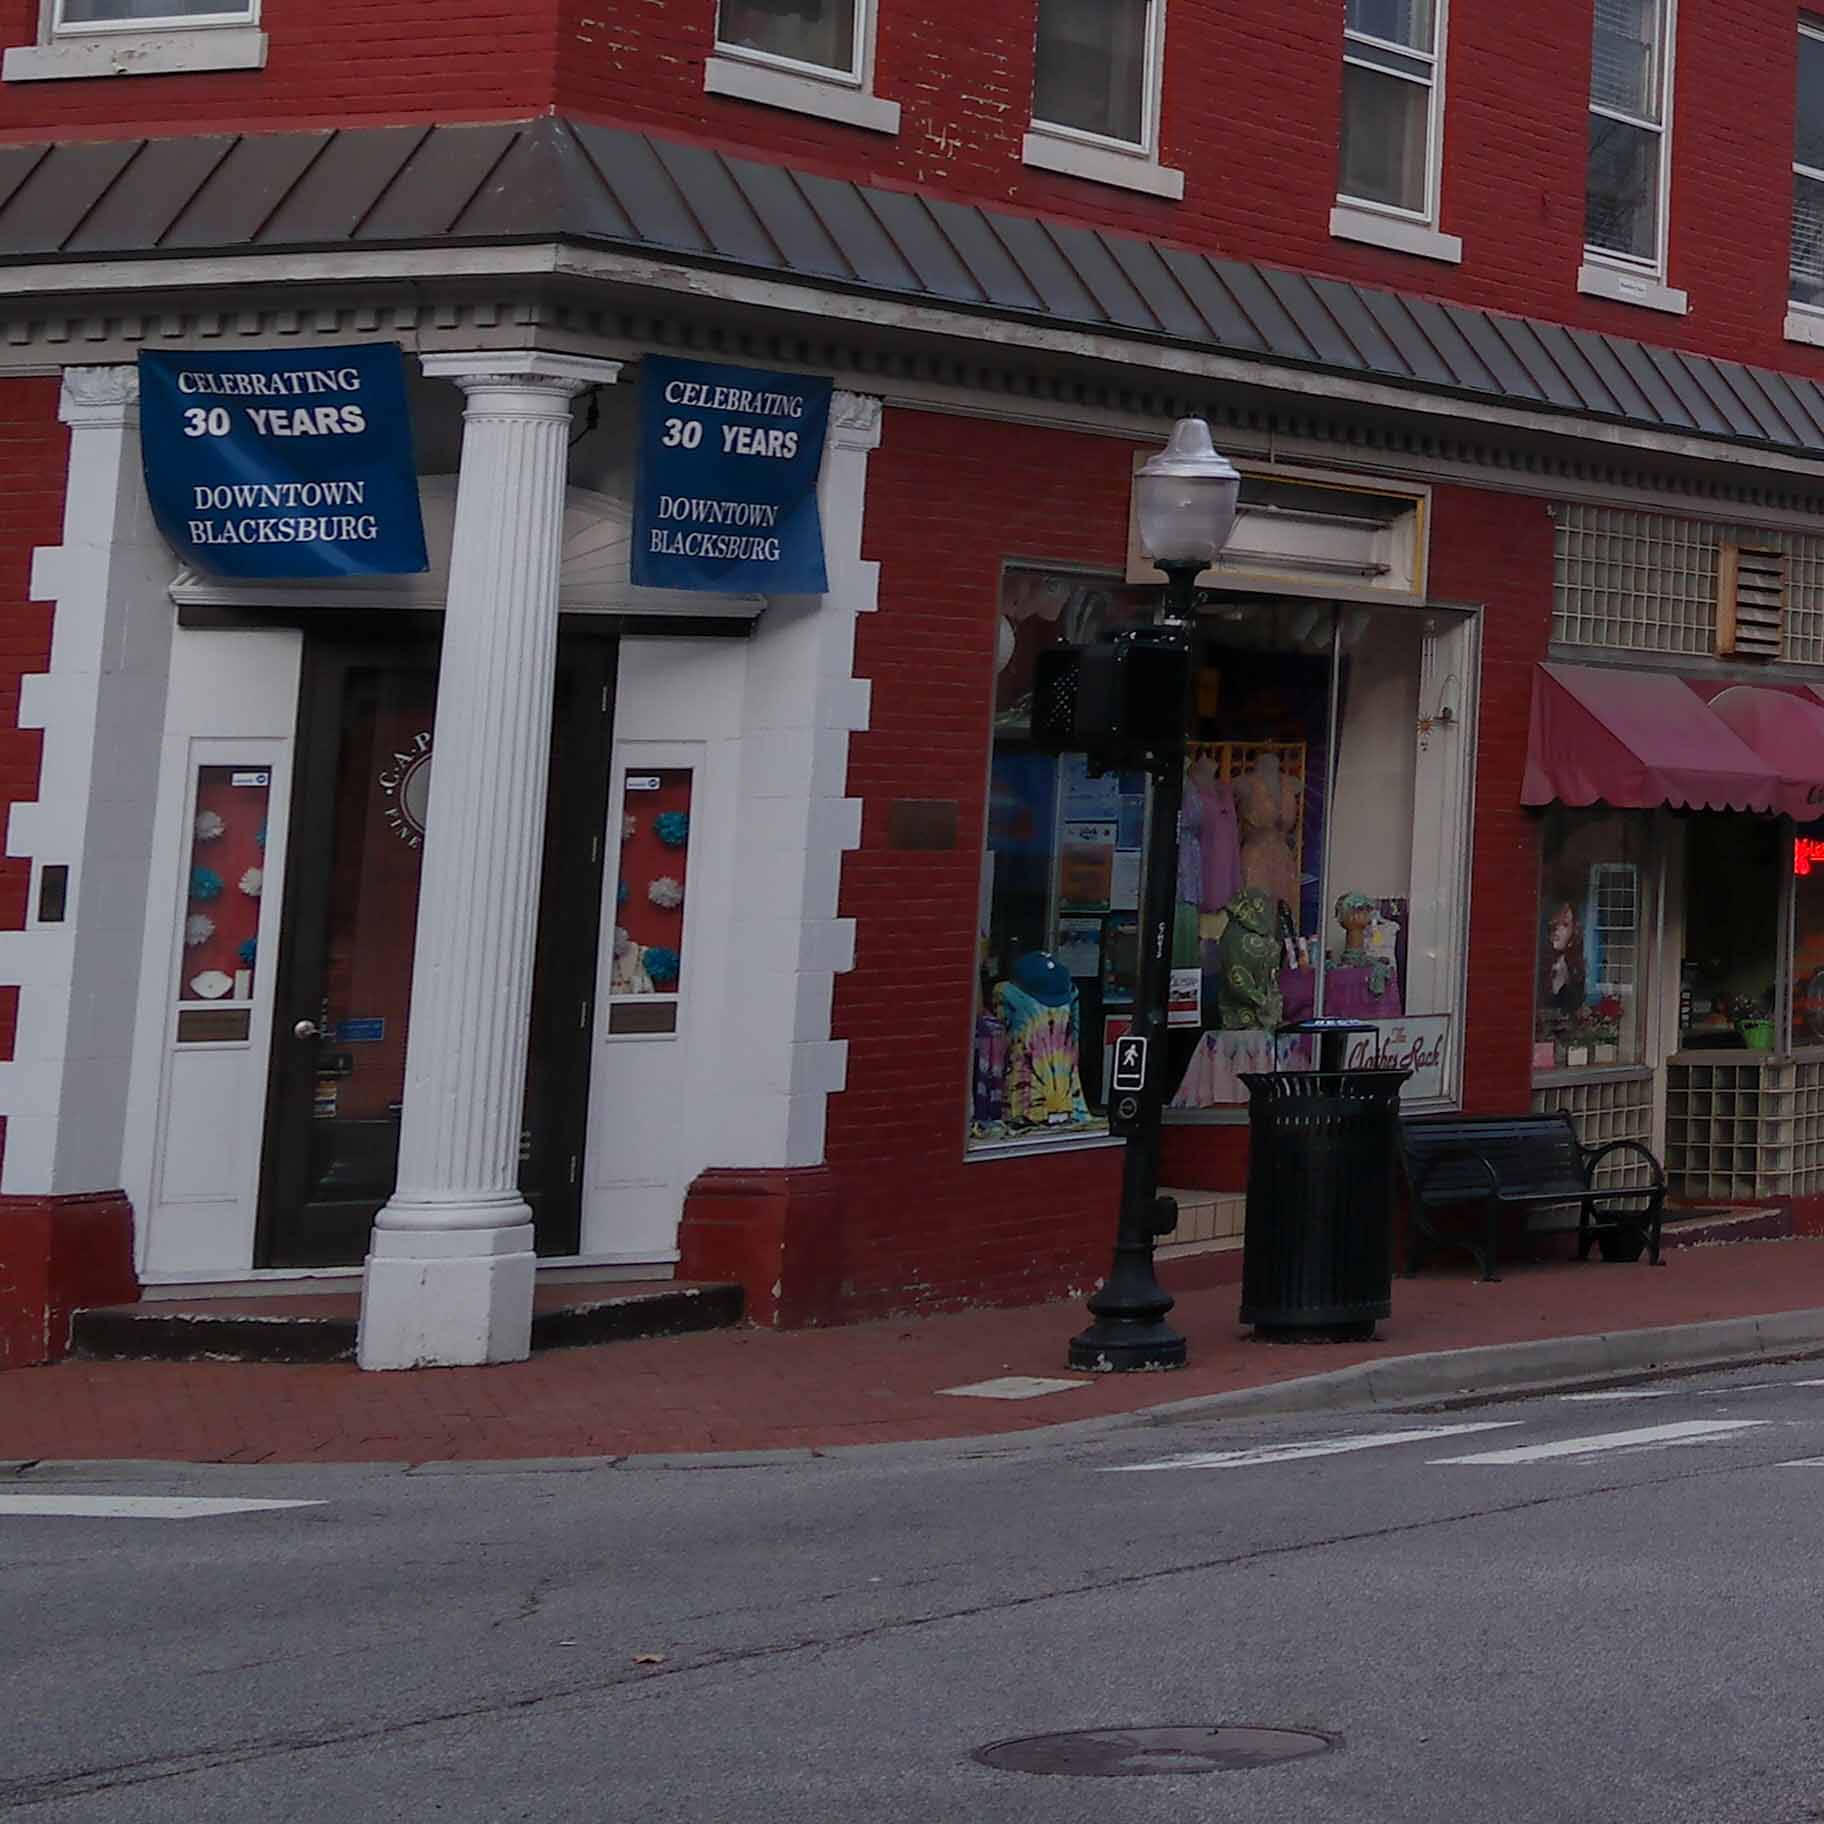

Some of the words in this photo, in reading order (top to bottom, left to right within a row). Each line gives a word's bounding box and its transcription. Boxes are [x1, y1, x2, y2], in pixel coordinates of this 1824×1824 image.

[176, 367, 361, 395] CELEBRATING
[664, 380, 803, 418] CELEBRATING
[183, 407, 232, 437] 30
[245, 404, 367, 437] YEARS
[661, 418, 703, 449] 30
[721, 424, 799, 459] YEARS
[193, 481, 365, 510] DOWNTOWN
[656, 495, 779, 527] DOWNTOWN
[188, 515, 378, 544] BLACKSBURG
[649, 528, 781, 561] BLACKSBURG
